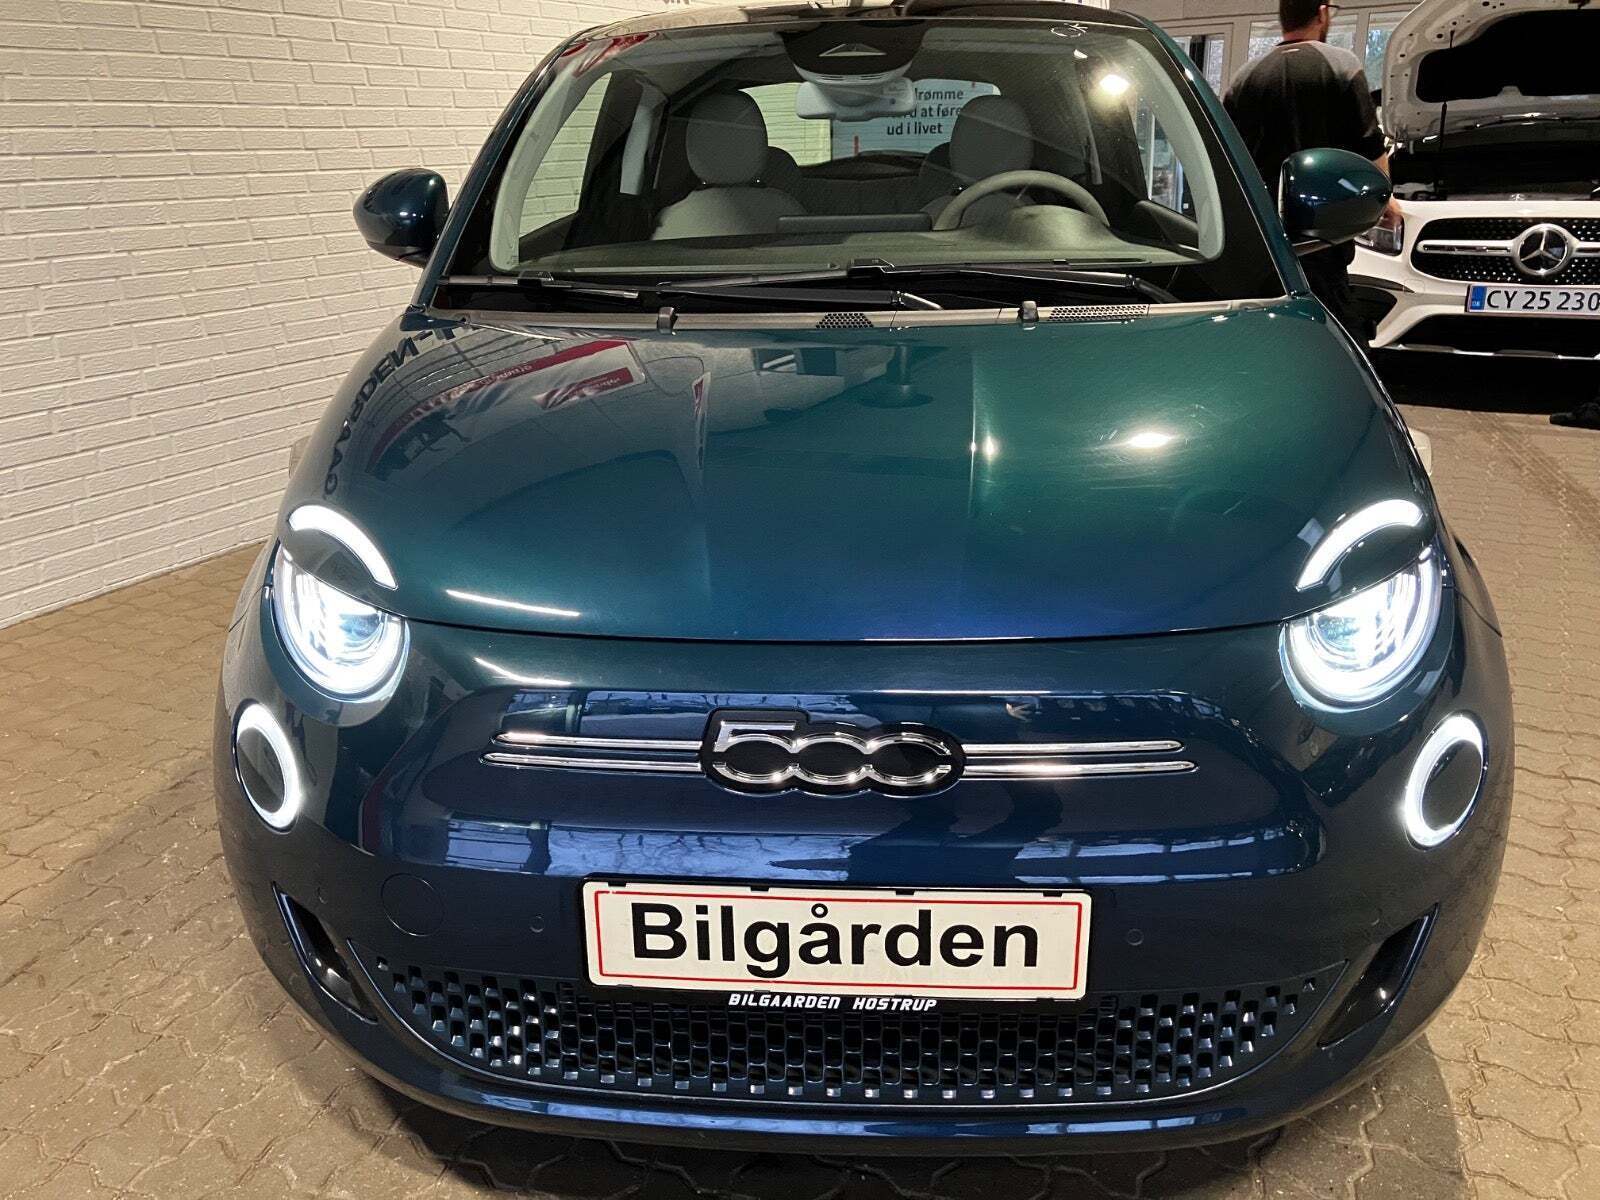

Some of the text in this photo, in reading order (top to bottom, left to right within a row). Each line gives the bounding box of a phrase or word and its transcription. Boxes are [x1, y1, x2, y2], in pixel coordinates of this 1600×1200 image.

[921, 105, 933, 117] at
[887, 122, 903, 135] ud
[914, 121, 943, 135] livet
[1487, 290, 1600, 311] CY 25 230
[712, 720, 952, 787] 500
[630, 902, 1039, 979] Bilgården
[728, 993, 938, 1012] BILGAARDEN HOSTRUP
